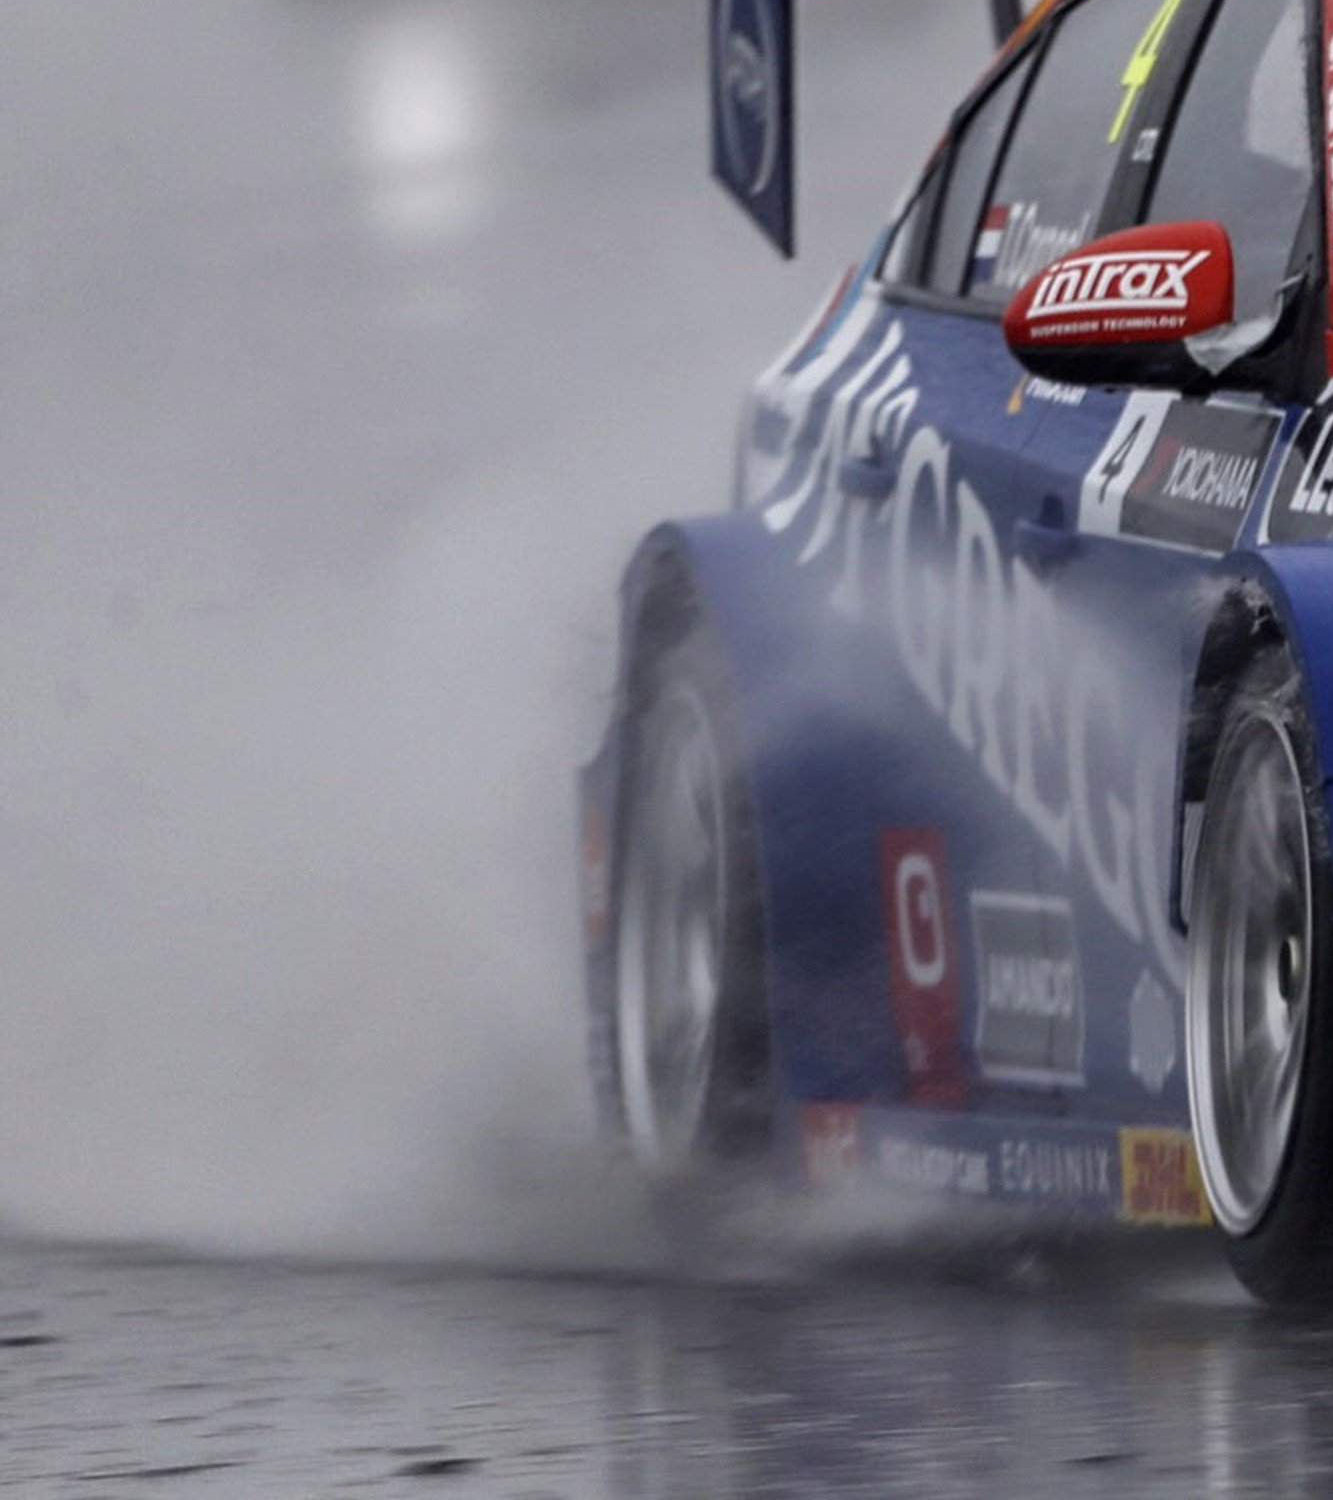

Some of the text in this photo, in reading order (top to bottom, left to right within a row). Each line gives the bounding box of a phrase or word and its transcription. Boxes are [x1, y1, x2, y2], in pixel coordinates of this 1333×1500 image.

[1030, 315, 1187, 338] SUSPENSION TECHNOLOGY
[1097, 414, 1147, 505] 4
